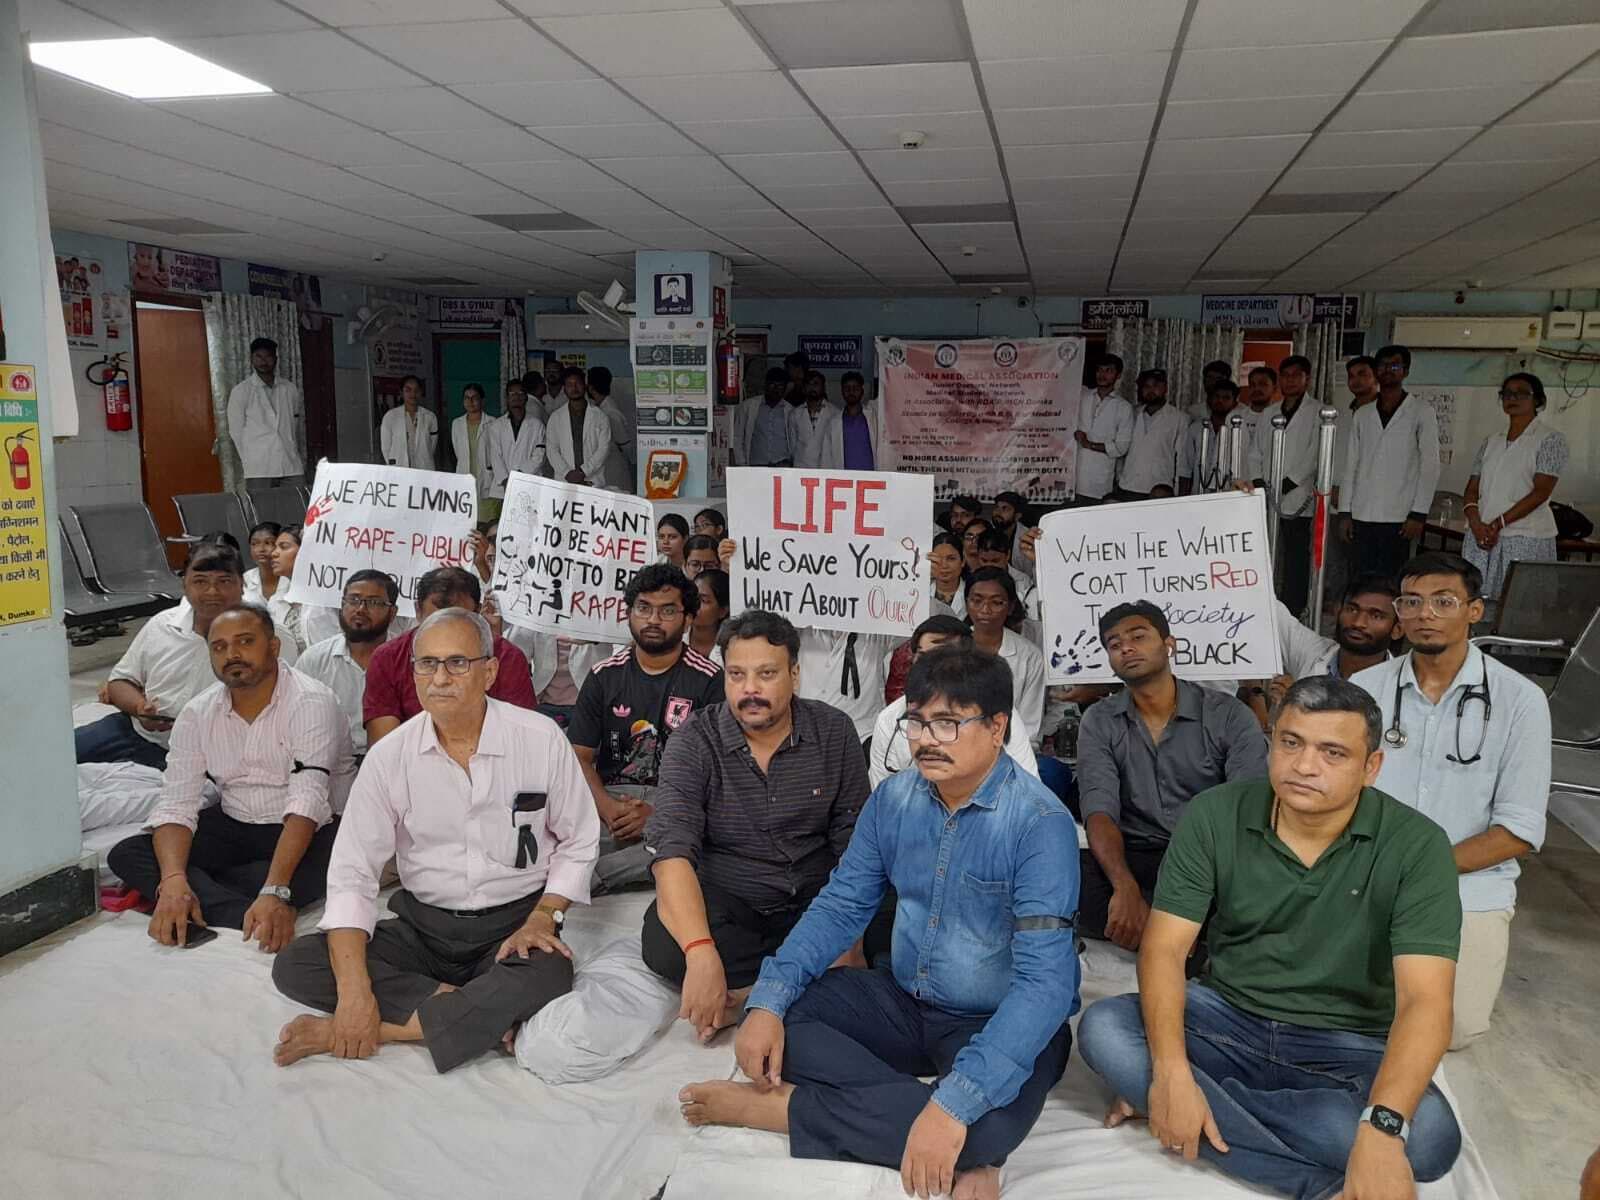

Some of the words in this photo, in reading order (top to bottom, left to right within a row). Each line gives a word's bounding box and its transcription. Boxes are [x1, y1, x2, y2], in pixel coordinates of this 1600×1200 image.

[1237, 300, 1278, 310] DEPARTMENT
[904, 372, 938, 380] INDIAN
[988, 372, 1059, 380] ASSOCIATION
[325, 480, 358, 504] WE
[360, 481, 399, 507] ARE
[408, 485, 473, 518] LIVING
[552, 498, 585, 524] WE
[591, 504, 650, 535] WANT
[773, 476, 886, 536] LIFE
[316, 520, 337, 545] IN
[544, 525, 562, 547] TO
[569, 529, 590, 553] BE
[592, 534, 647, 564] SAFE
[1056, 535, 1127, 563] WHEN
[1130, 531, 1168, 560] THE
[1178, 526, 1253, 555] WHITE
[308, 563, 348, 591] NOT
[537, 552, 575, 580] NOT
[577, 561, 603, 587] TO
[1070, 571, 1128, 595] COAT
[1137, 566, 1208, 593] TURNS
[1210, 561, 1258, 589] RED
[570, 591, 629, 623] RAPE
[743, 577, 793, 612] WHAT
[799, 582, 860, 619] ABOUT
[1162, 602, 1255, 639] Society
[1175, 638, 1253, 665] BLACK
